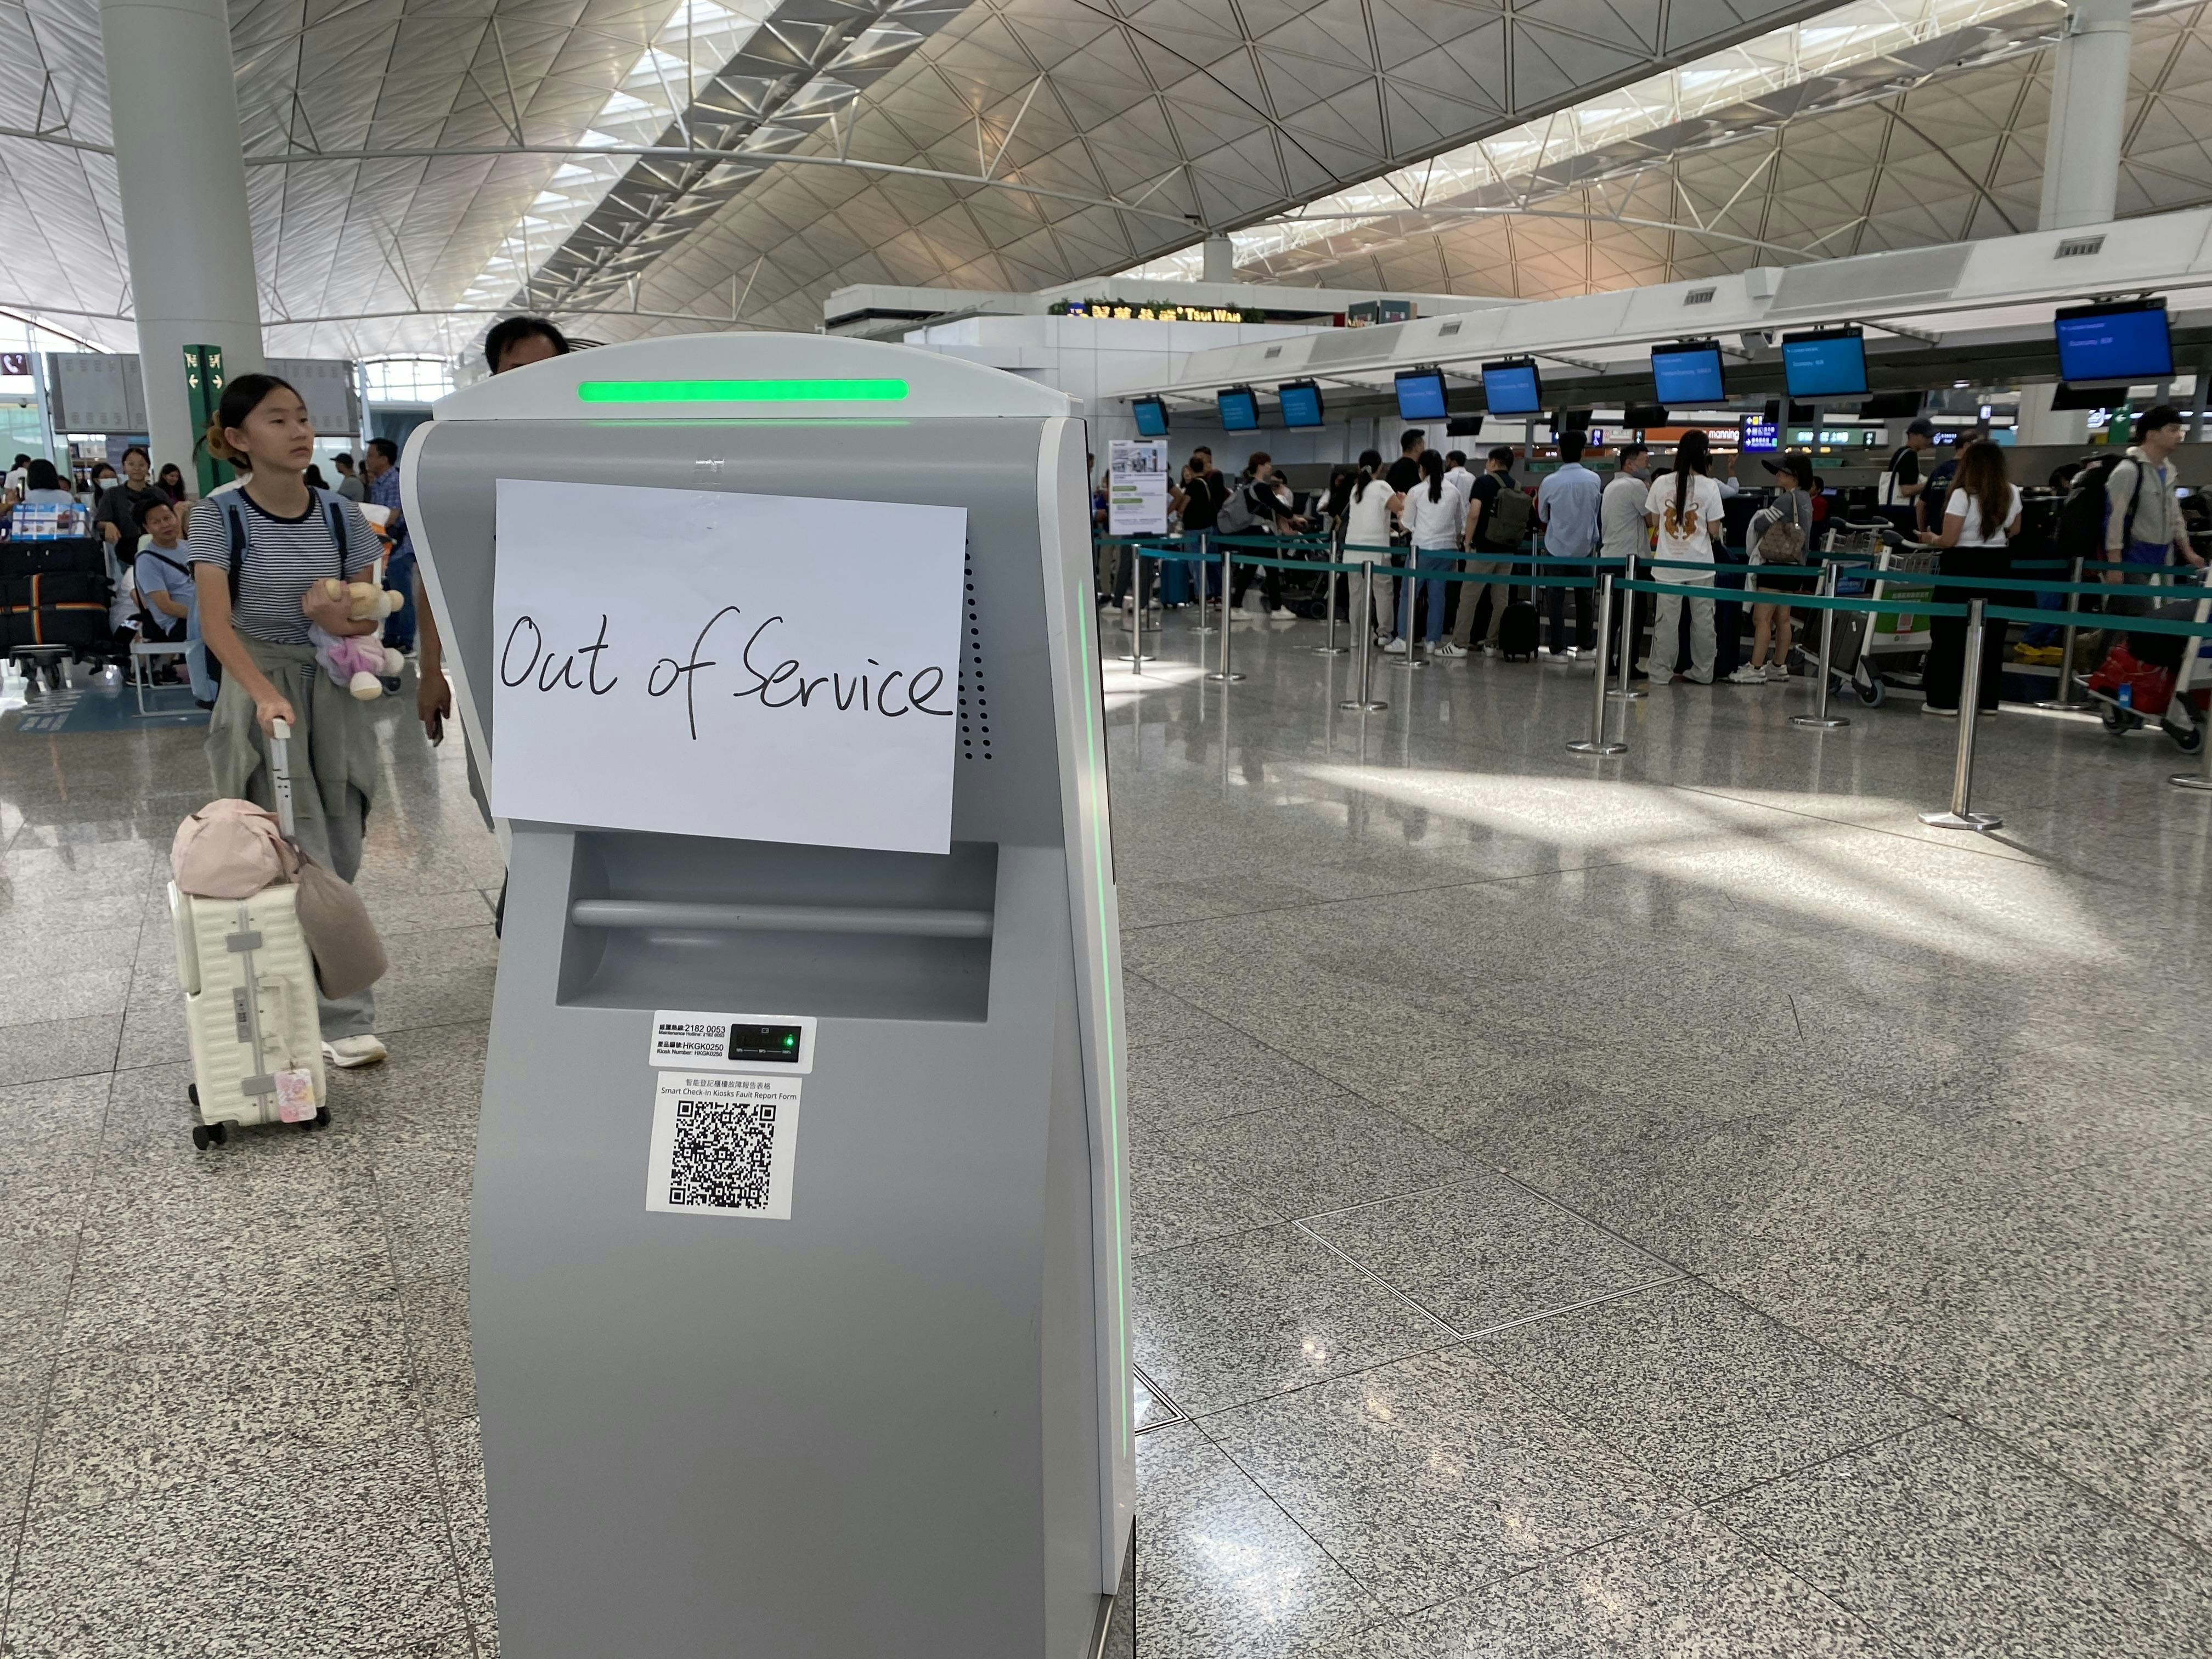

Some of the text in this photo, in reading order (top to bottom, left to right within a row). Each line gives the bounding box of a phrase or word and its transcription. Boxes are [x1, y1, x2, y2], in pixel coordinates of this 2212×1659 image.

[500, 605, 953, 741] Out of Service
[706, 1025, 726, 1034] 0053
[754, 1092, 777, 1101] Report
